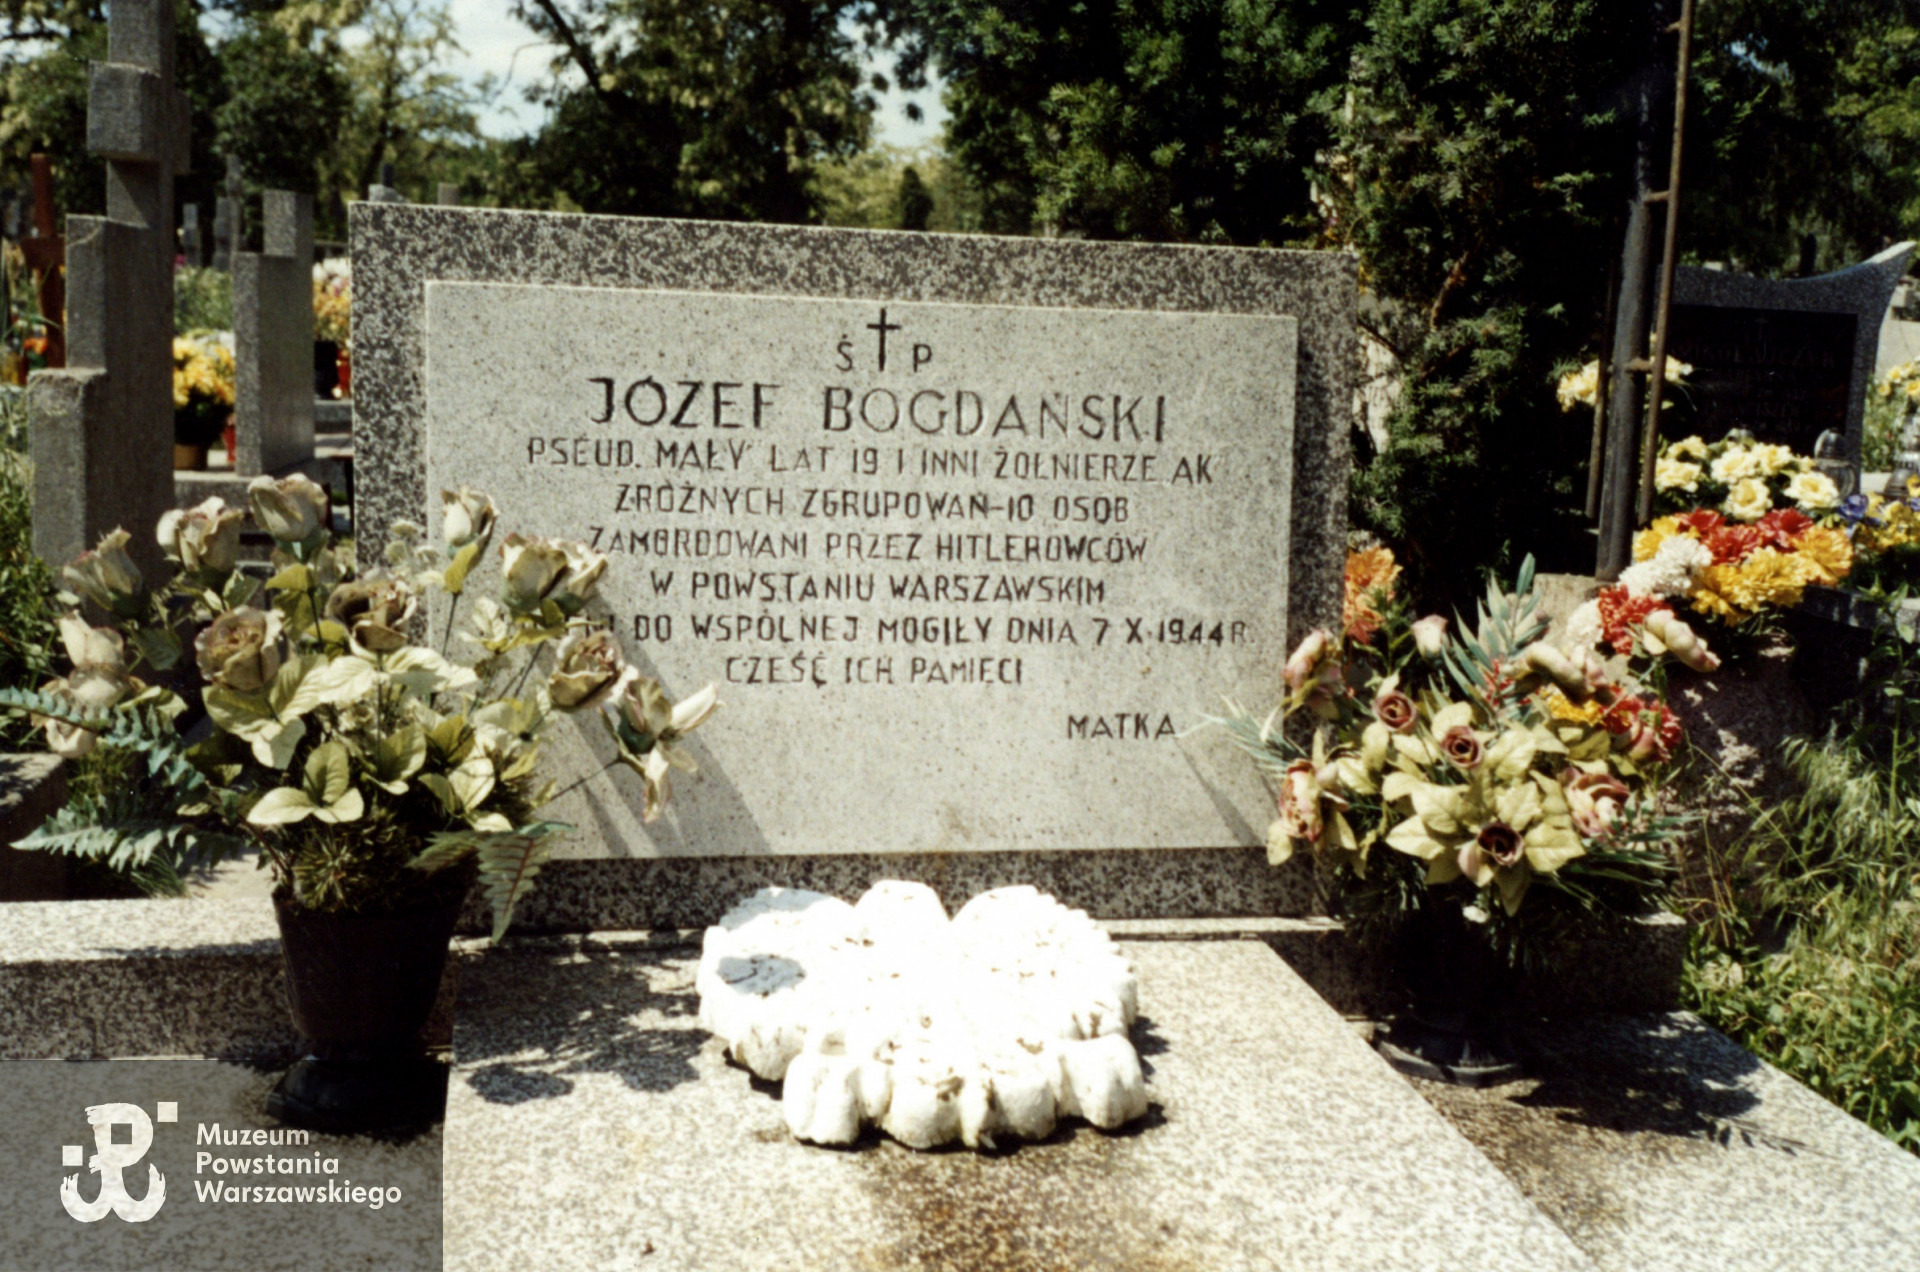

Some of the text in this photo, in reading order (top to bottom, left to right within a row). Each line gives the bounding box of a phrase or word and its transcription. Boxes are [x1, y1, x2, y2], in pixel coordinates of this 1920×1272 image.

[586, 375, 1166, 443] JÓZEF BOGDAŃSKI
[656, 439, 749, 472] MAŁY
[770, 444, 833, 472] LAT
[853, 447, 878, 475] 19
[897, 450, 903, 475] I
[922, 450, 979, 476] INNI
[1171, 454, 1213, 484] AK
[589, 526, 1148, 563] ZAMORDOWANI PRZEZ HITLEROWCÓW
[650, 571, 1106, 605] W POWSTANIU WARSZAWSKIM
[634, 614, 673, 642] DO
[691, 609, 858, 642] WSPÓLNEJ
[1007, 617, 1078, 646] DNIA
[1092, 618, 1110, 646] 7
[845, 656, 894, 684] ICH
[1067, 713, 1176, 740] MATKA
